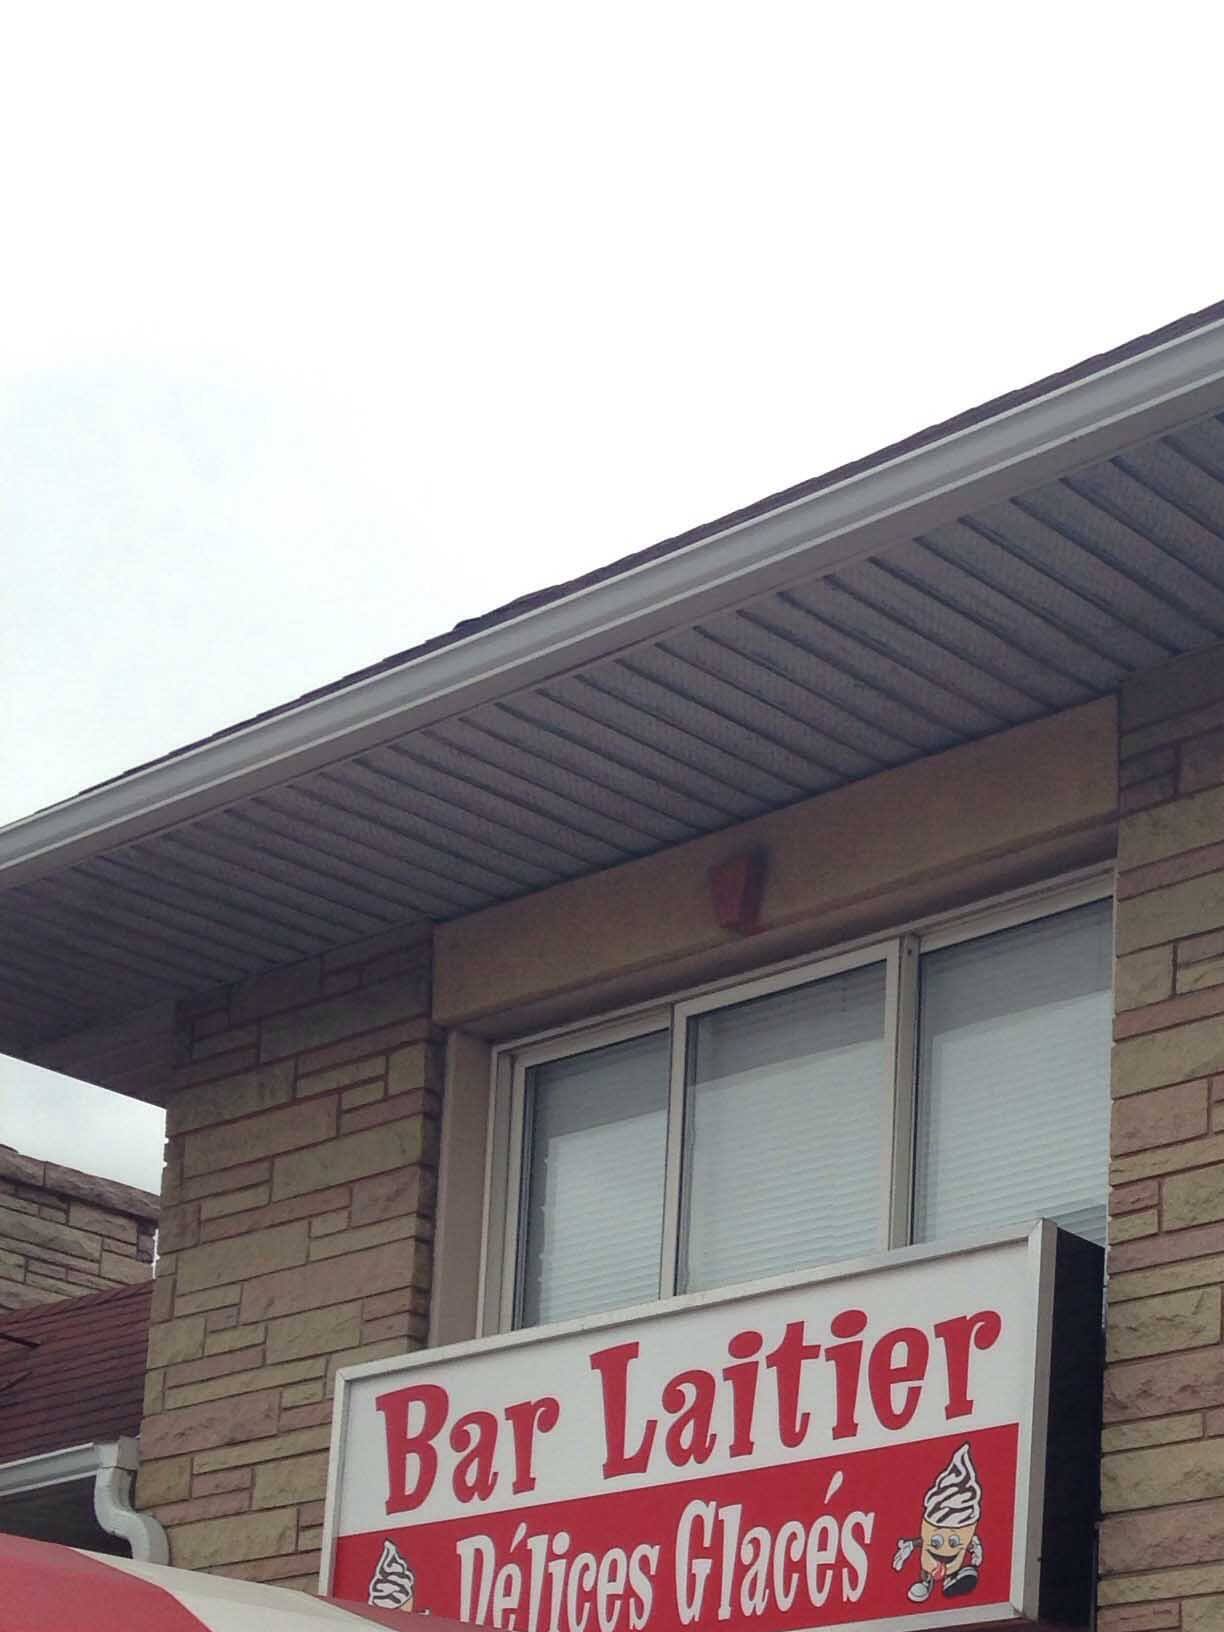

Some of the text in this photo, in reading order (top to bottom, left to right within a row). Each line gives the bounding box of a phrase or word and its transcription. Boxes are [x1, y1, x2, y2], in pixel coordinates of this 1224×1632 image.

[375, 1308, 1002, 1515] Bar Laitier
[675, 1470, 876, 1626] Glacés
